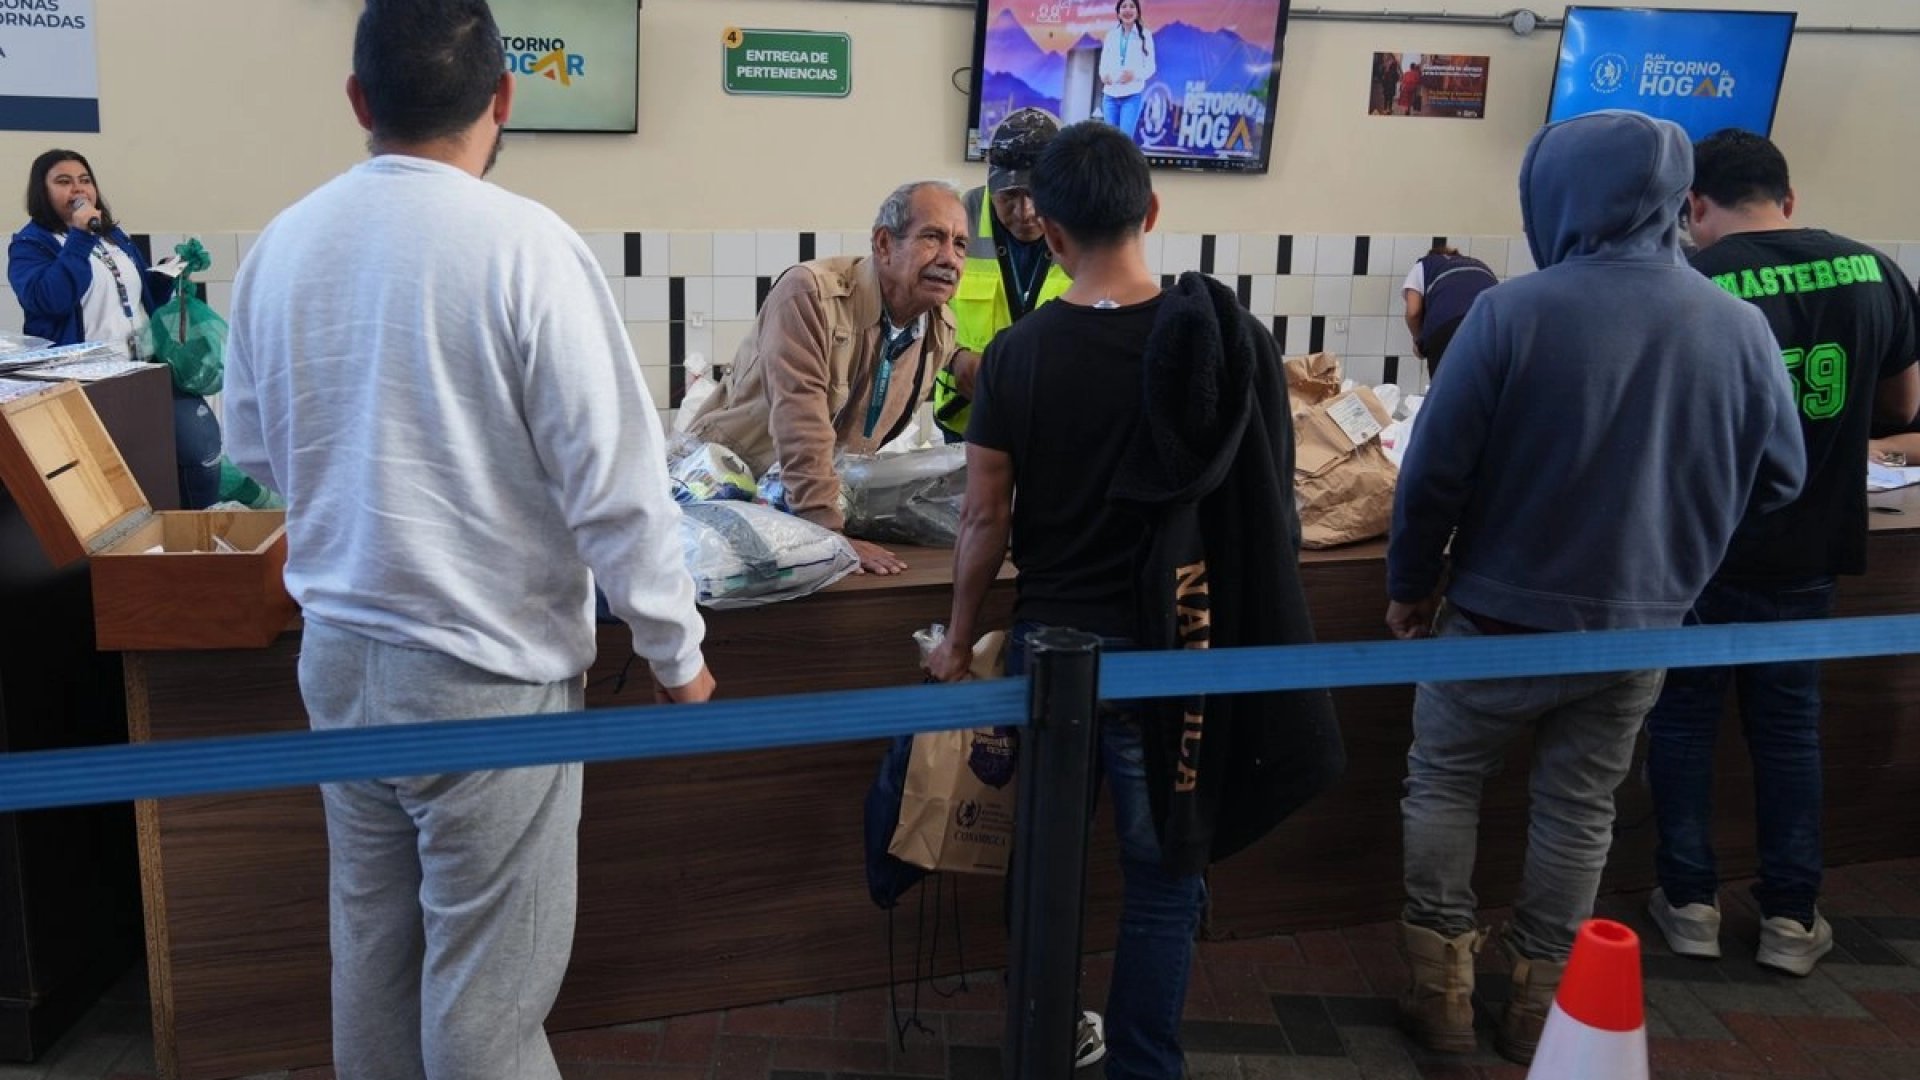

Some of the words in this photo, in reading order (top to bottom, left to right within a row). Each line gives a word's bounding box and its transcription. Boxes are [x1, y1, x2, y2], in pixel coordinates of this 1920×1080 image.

[501, 36, 566, 52] TORNO
[727, 31, 738, 43] 4
[746, 49, 809, 63] ENTREGA
[811, 51, 829, 64] DE
[1644, 52, 1666, 61] PLAN
[504, 47, 584, 87] OGAR
[736, 66, 838, 80] PERTENENCIAS
[1643, 60, 1721, 75] RETORNO
[1638, 75, 1735, 98] HOGAR
[1182, 92, 1257, 116] RETORNO
[1712, 254, 1883, 299] MASTERSON
[1174, 559, 1211, 793] NAICA
